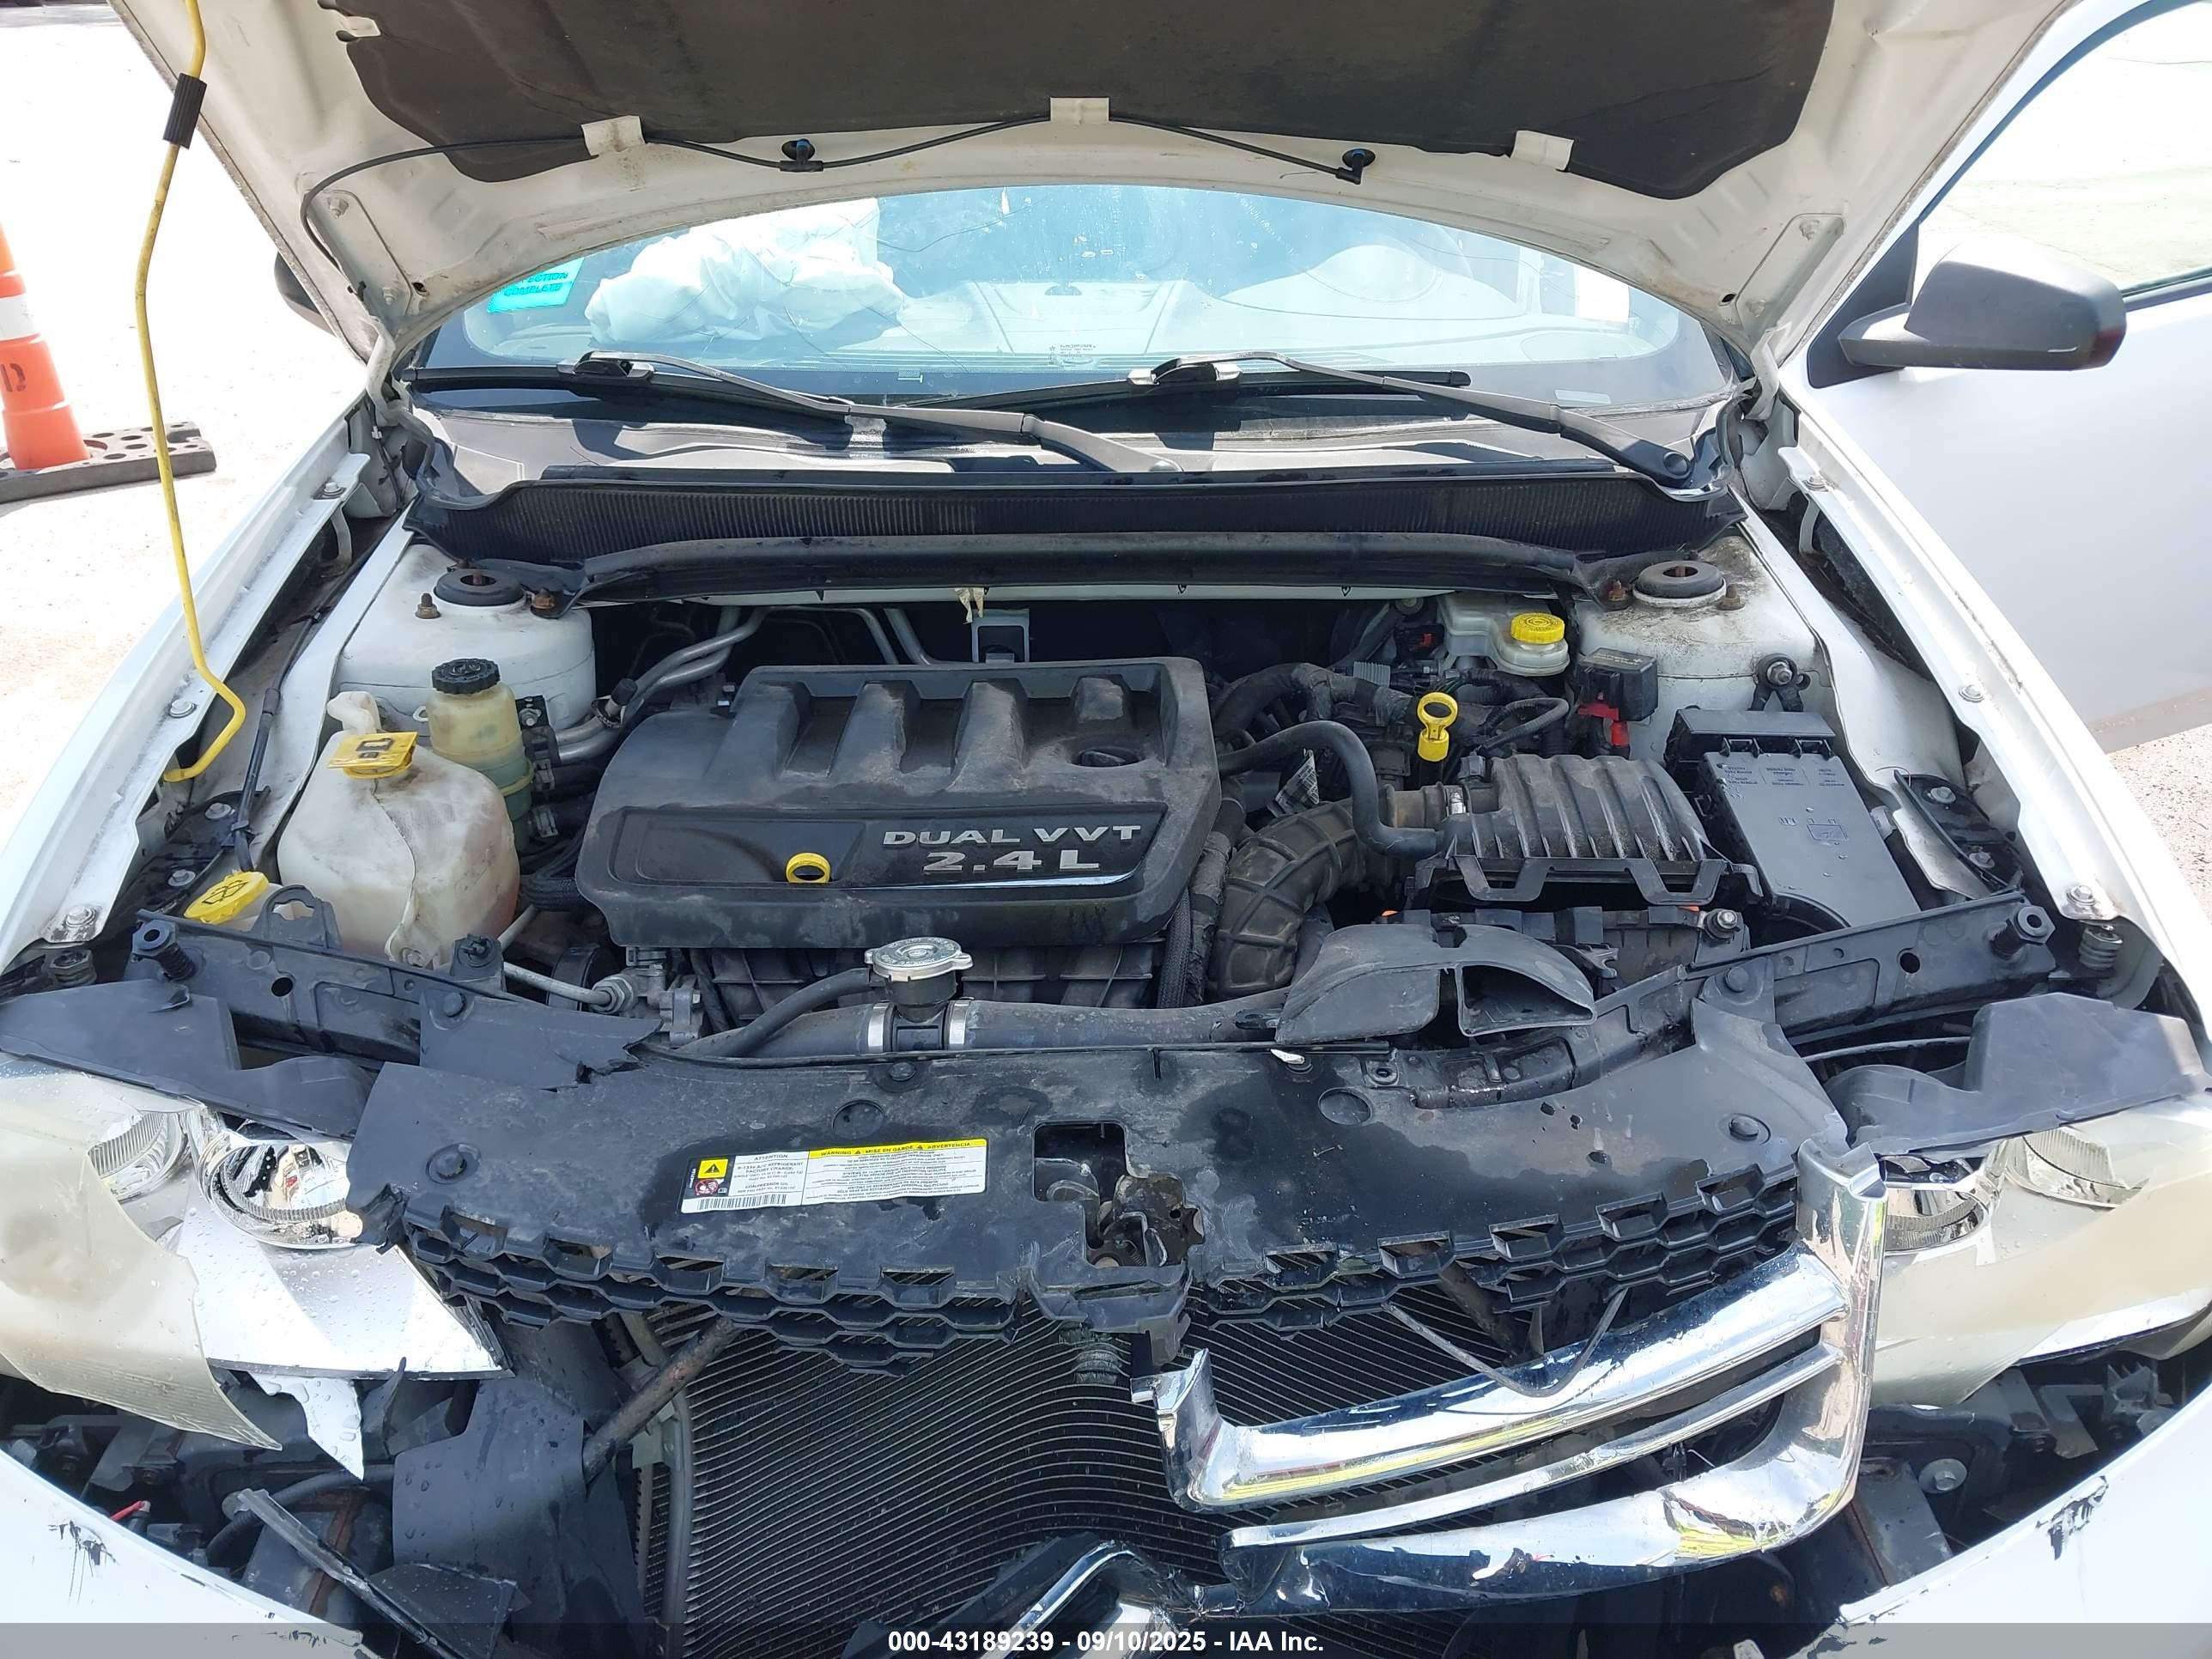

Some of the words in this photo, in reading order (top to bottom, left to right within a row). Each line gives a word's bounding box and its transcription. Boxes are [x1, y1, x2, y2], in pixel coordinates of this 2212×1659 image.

[504, 283, 563, 296] COMPLETE
[883, 829, 1021, 846] DUAL
[1033, 825, 1141, 843] VVT
